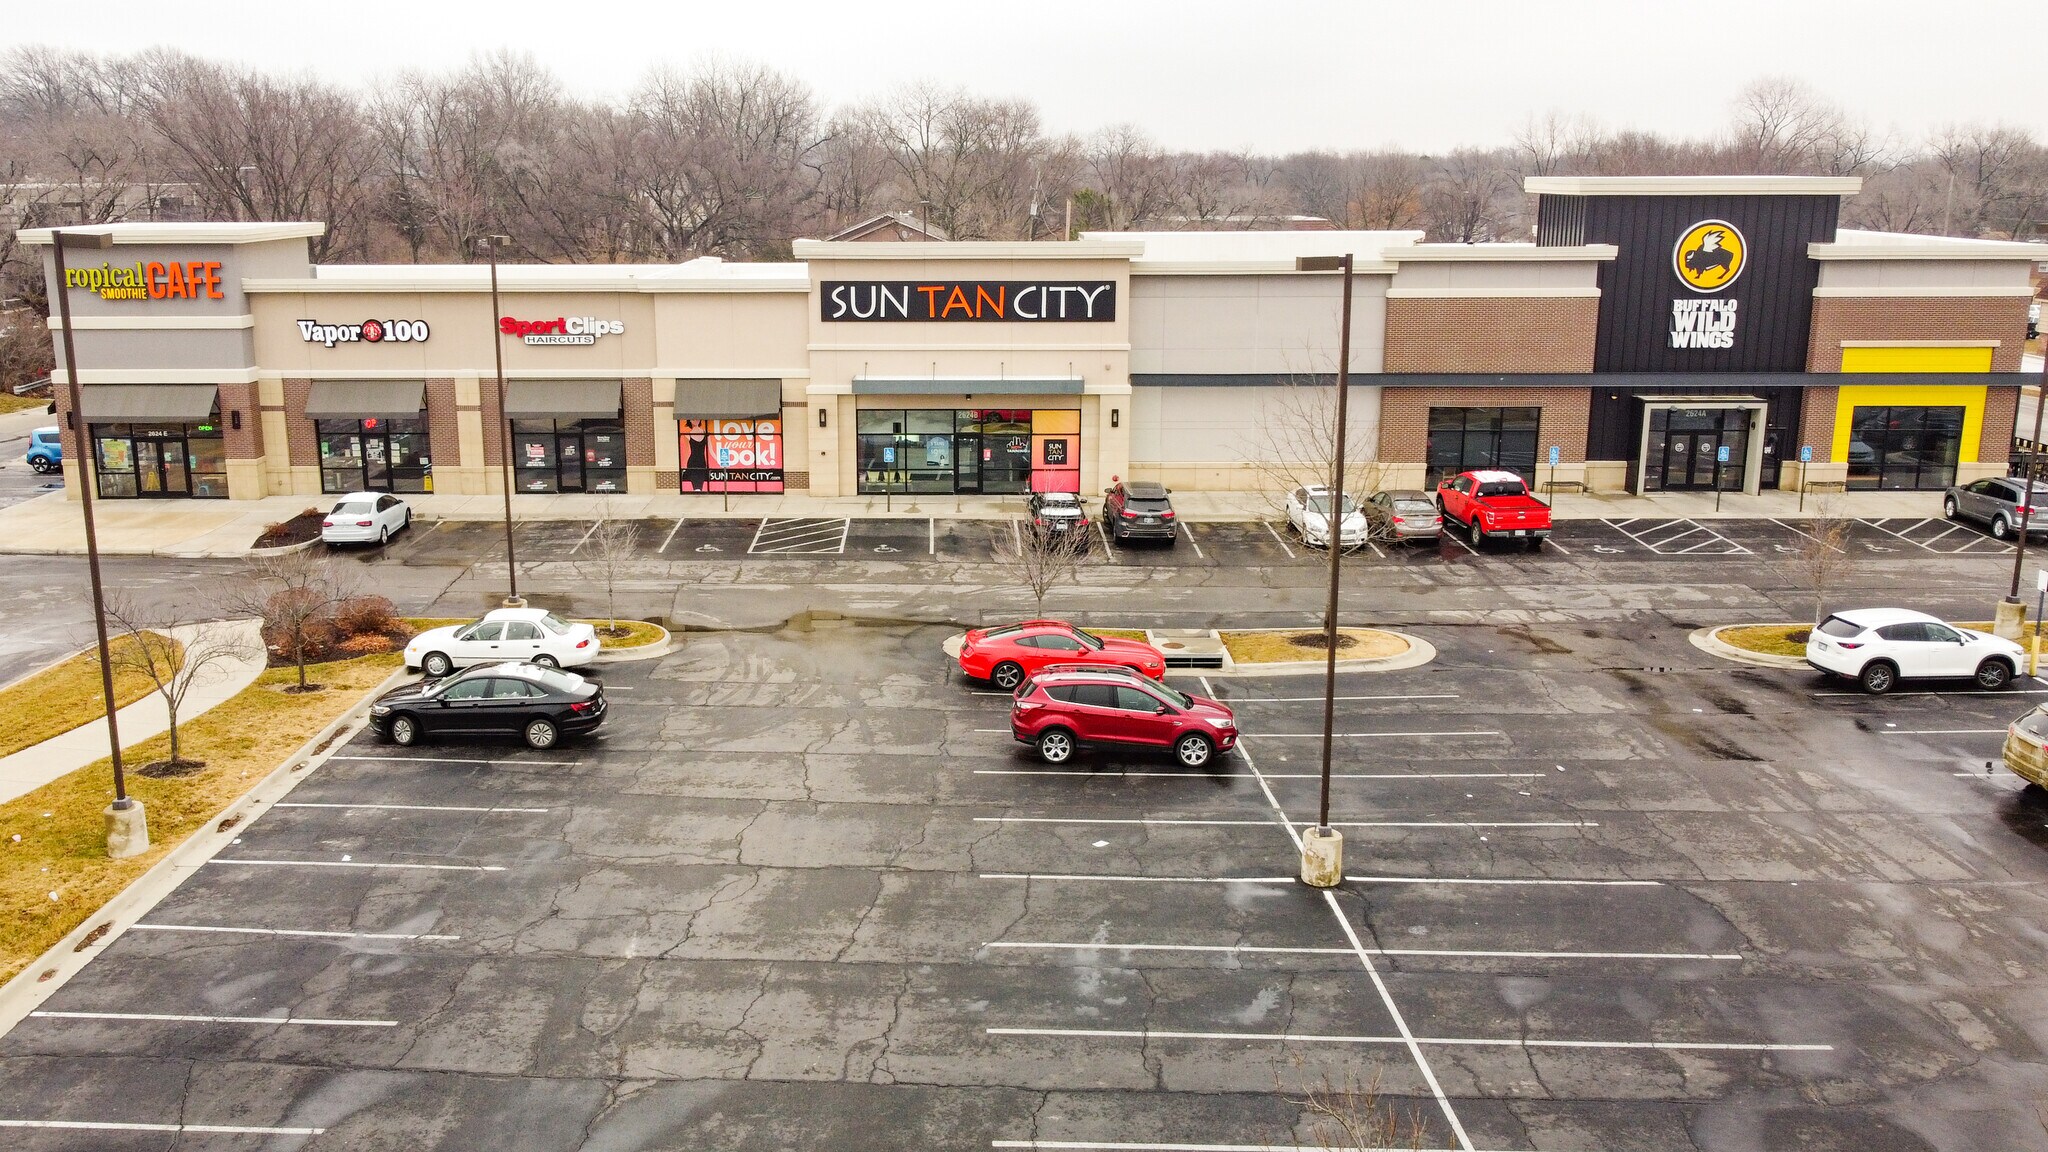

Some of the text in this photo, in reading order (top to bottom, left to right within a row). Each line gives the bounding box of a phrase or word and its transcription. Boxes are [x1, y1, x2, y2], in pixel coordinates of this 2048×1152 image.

[146, 261, 224, 299] CAFE
[101, 287, 148, 300] SMOOTHIE
[831, 284, 909, 319] SUN
[916, 284, 1005, 319] TAN
[1673, 299, 1738, 312] BUFFALO
[1672, 311, 1737, 332] WILD
[297, 320, 429, 348] Vapor 100
[1670, 331, 1734, 348] WINGS
[713, 419, 775, 441] love
[724, 440, 755, 450] your
